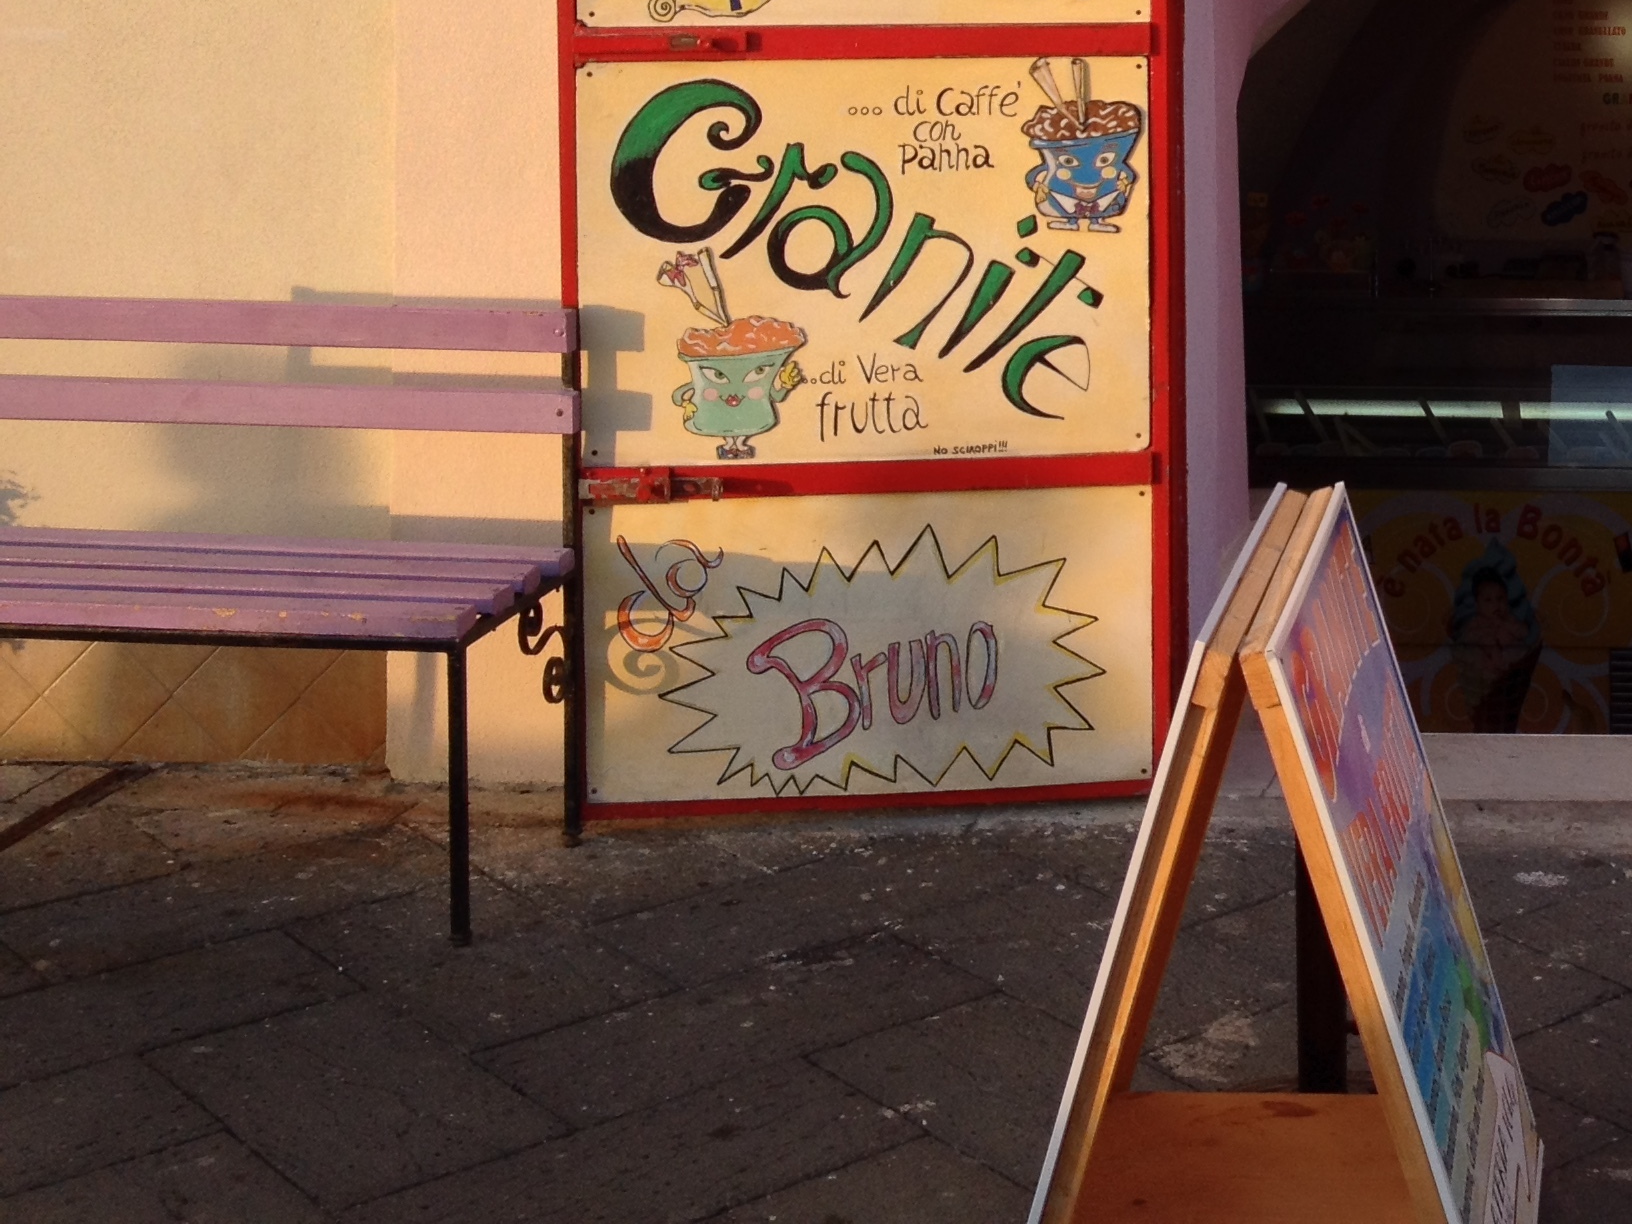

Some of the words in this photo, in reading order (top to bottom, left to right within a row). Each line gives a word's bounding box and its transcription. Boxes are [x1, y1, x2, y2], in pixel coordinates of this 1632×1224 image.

[913, 118, 962, 144] con
[610, 77, 1104, 420] Granite
[858, 354, 925, 386] Vera
[816, 391, 929, 443] frutta
[933, 444, 949, 456] NO
[1397, 515, 1464, 574] nata
[1473, 502, 1502, 534] la
[746, 619, 998, 770] Bruno
